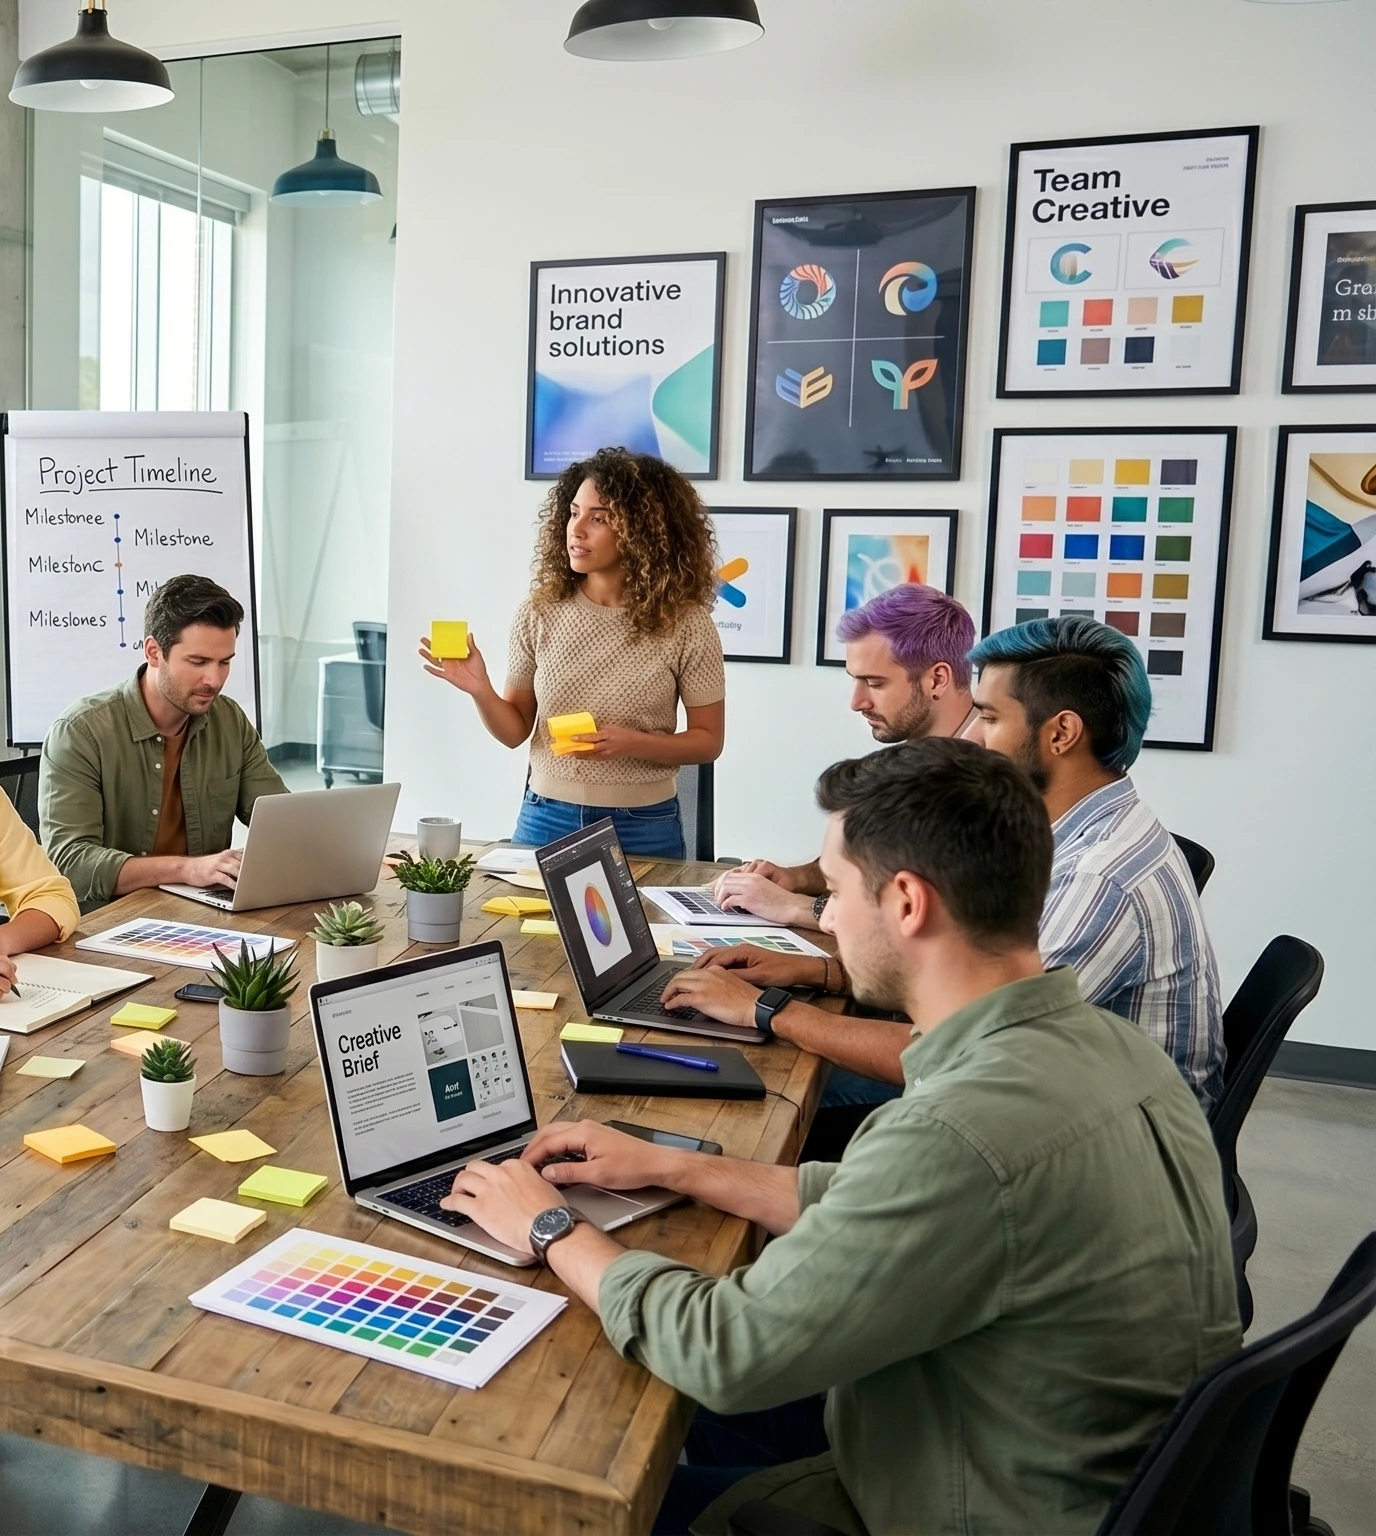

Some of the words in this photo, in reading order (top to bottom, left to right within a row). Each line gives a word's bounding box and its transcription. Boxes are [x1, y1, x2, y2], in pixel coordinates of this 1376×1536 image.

[1033, 168, 1121, 193] Team
[1032, 193, 1171, 224] Creative
[550, 279, 682, 305] Innovative
[550, 307, 623, 331] brand
[549, 334, 665, 358] solutions
[39, 456, 119, 495] Project
[123, 454, 218, 484] Timeline
[25, 507, 105, 526] Milestonee
[135, 528, 214, 547] Milestone
[338, 1024, 402, 1054] Creative
[342, 1050, 380, 1078] Brief
